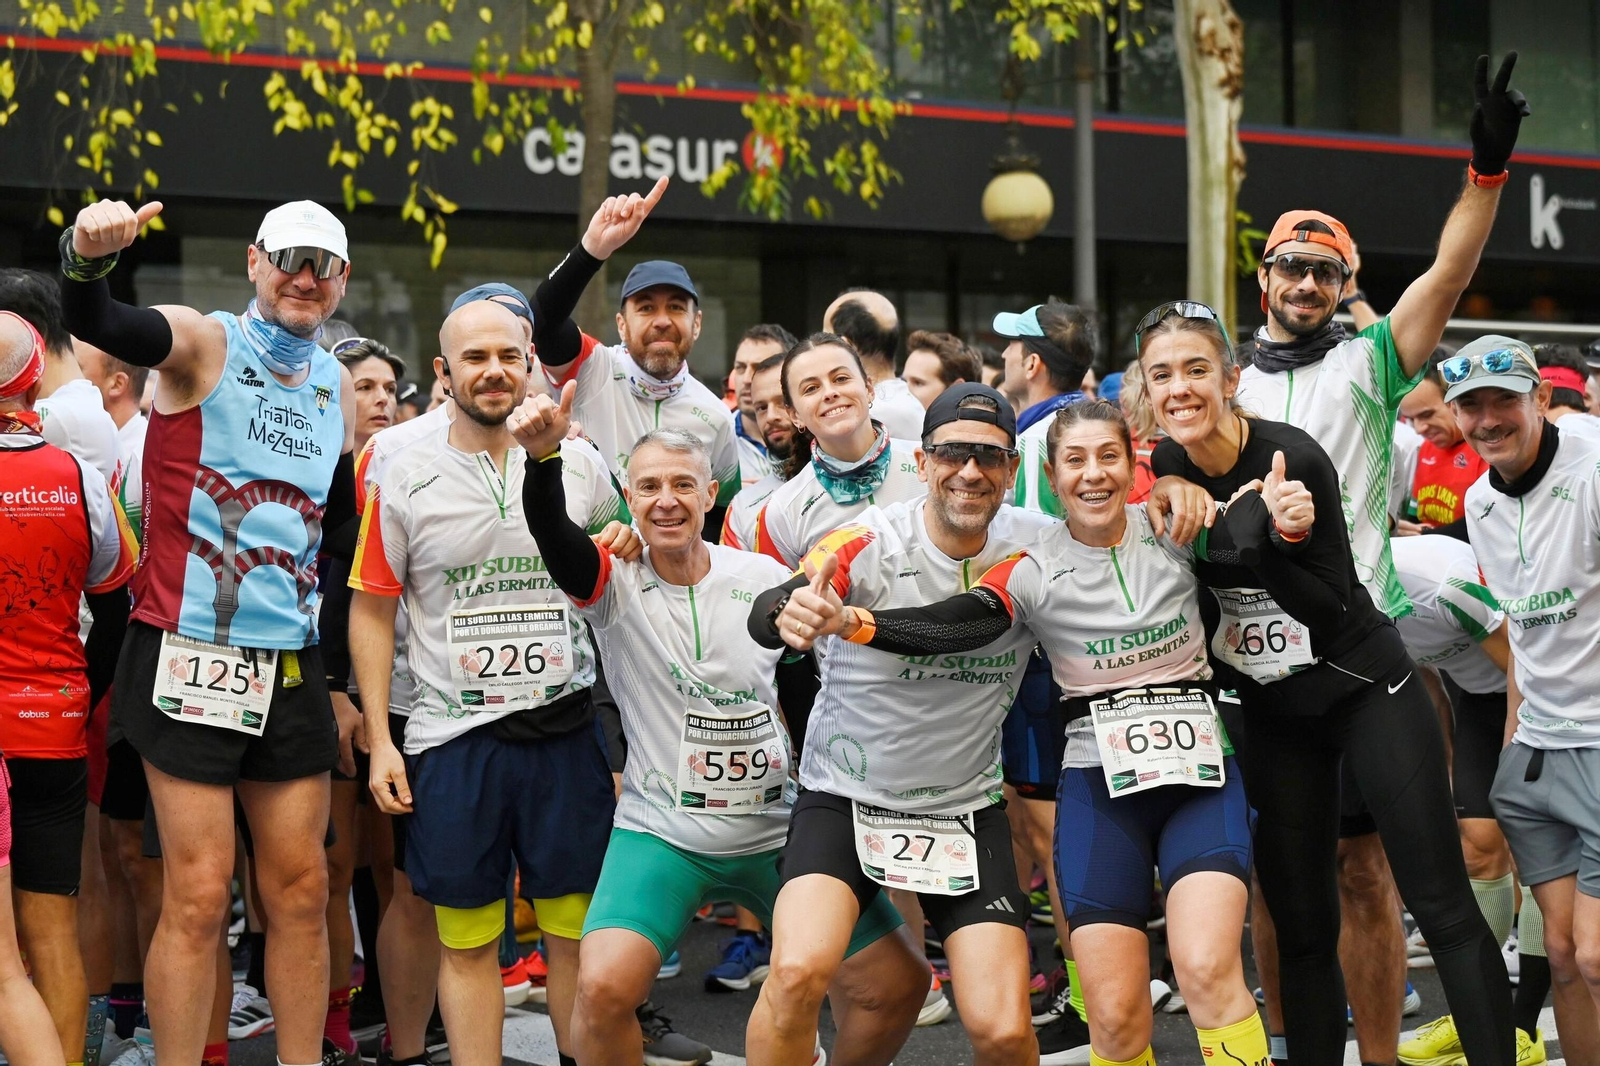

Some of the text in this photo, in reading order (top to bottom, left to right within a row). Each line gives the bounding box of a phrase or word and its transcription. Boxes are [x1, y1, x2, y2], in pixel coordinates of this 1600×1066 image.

[523, 126, 738, 184] caasur
[1530, 172, 1564, 250] k
[237, 377, 265, 388] VIATOR
[691, 407, 709, 422] SIG
[0, 485, 78, 505] erticalia
[1551, 487, 1570, 500] SIG
[442, 555, 547, 586] XII SUBI
[453, 589, 461, 600] A
[465, 581, 495, 598] LAS
[731, 588, 752, 603] SIG
[1513, 587, 1577, 614] SUBIDA
[454, 612, 559, 626] XII SUBIDA A LAS ERMITAS
[1522, 608, 1578, 630] ERMITAS
[455, 629, 470, 637] POR
[1083, 613, 1188, 656] XII SUBIDA
[1093, 631, 1190, 669] A LAS ERMITAS
[476, 642, 546, 678] 226
[184, 656, 250, 695] 125
[1112, 697, 1142, 709] SUBIDA
[1150, 696, 1165, 704] LAS
[1166, 693, 1202, 703] ERMITAS
[19, 710, 50, 718] dobuss
[689, 717, 699, 727] XII
[701, 719, 732, 729] SUBIDA
[733, 721, 739, 729] A
[741, 720, 752, 728] LAS
[1100, 710, 1116, 718] POR
[688, 729, 701, 738] POR
[703, 731, 711, 740] LA
[712, 731, 749, 741] DONACIÓN
[750, 731, 757, 739] DE
[1125, 720, 1196, 754] 630
[703, 748, 769, 782] 559
[875, 816, 883, 825] LA
[924, 819, 932, 827] DE
[933, 821, 963, 830] ORGANO
[892, 834, 935, 862] 27
